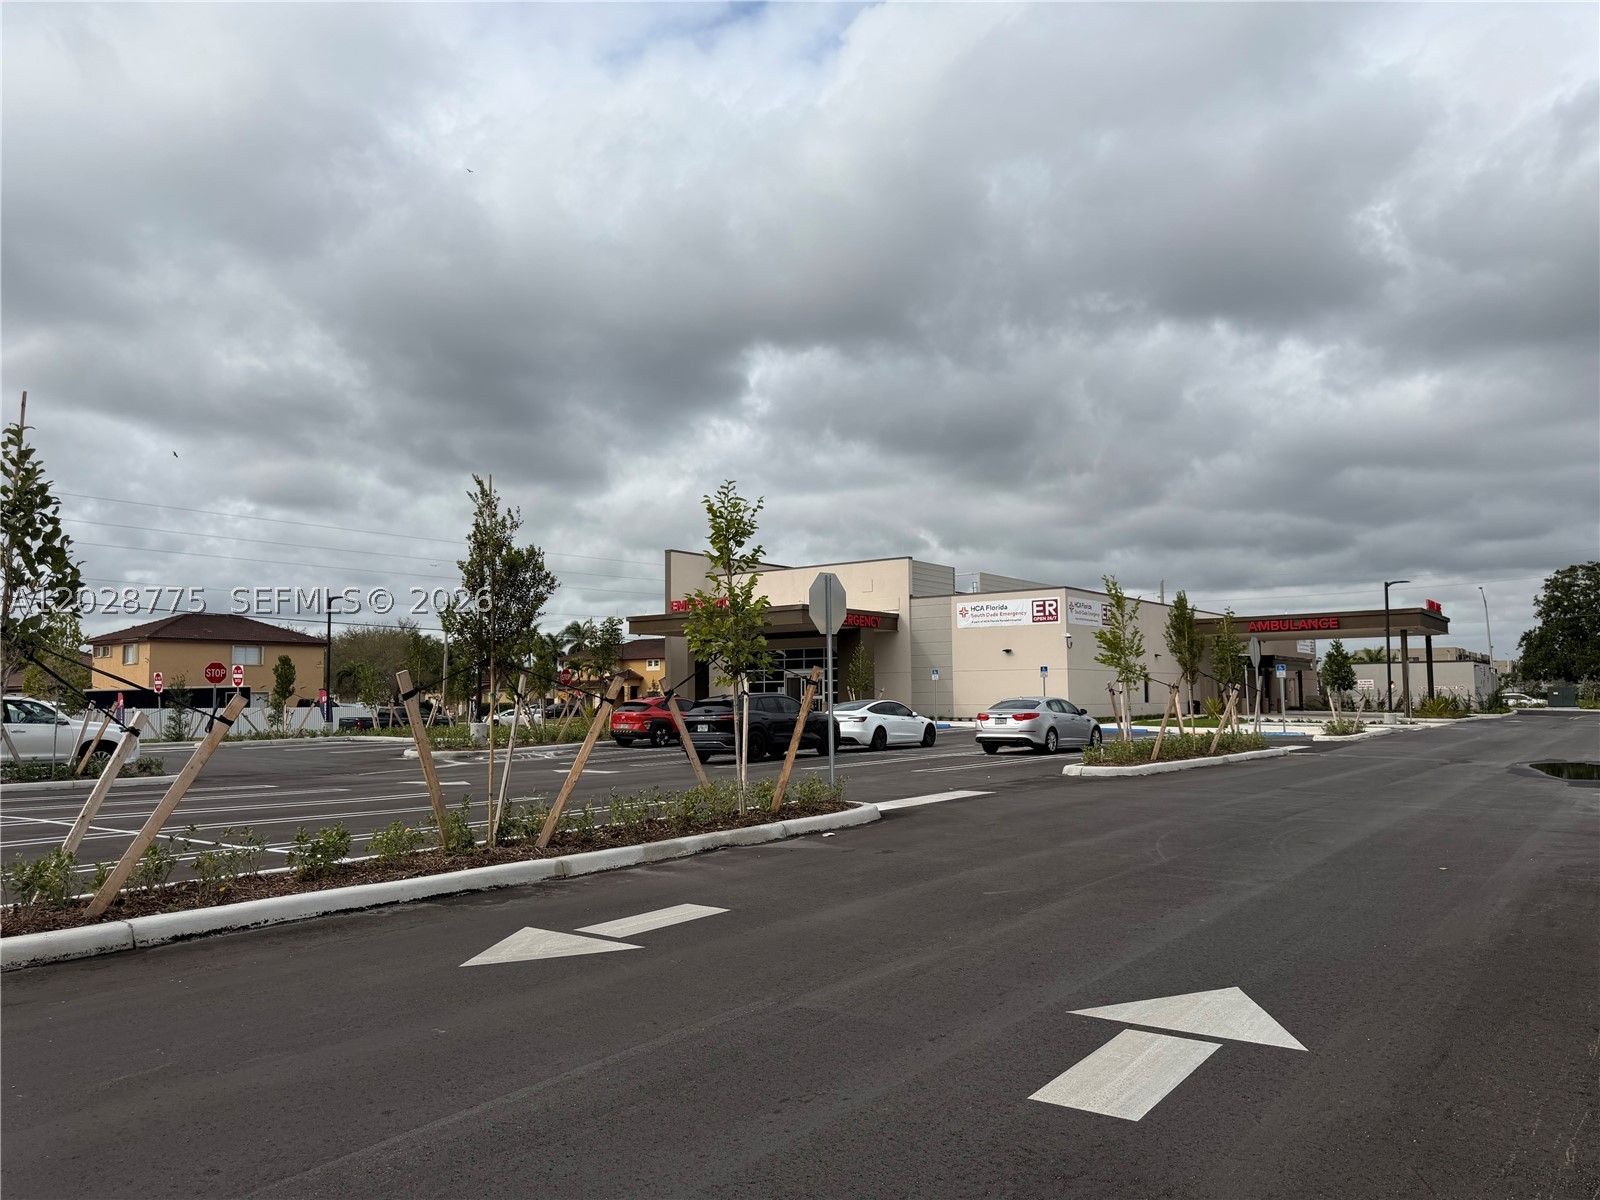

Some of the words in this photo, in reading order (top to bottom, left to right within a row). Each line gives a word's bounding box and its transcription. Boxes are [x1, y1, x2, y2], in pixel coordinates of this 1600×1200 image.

[1033, 601, 1057, 616] ER
[1248, 617, 1339, 631] AMBULANCE
[206, 668, 226, 677] STOP
